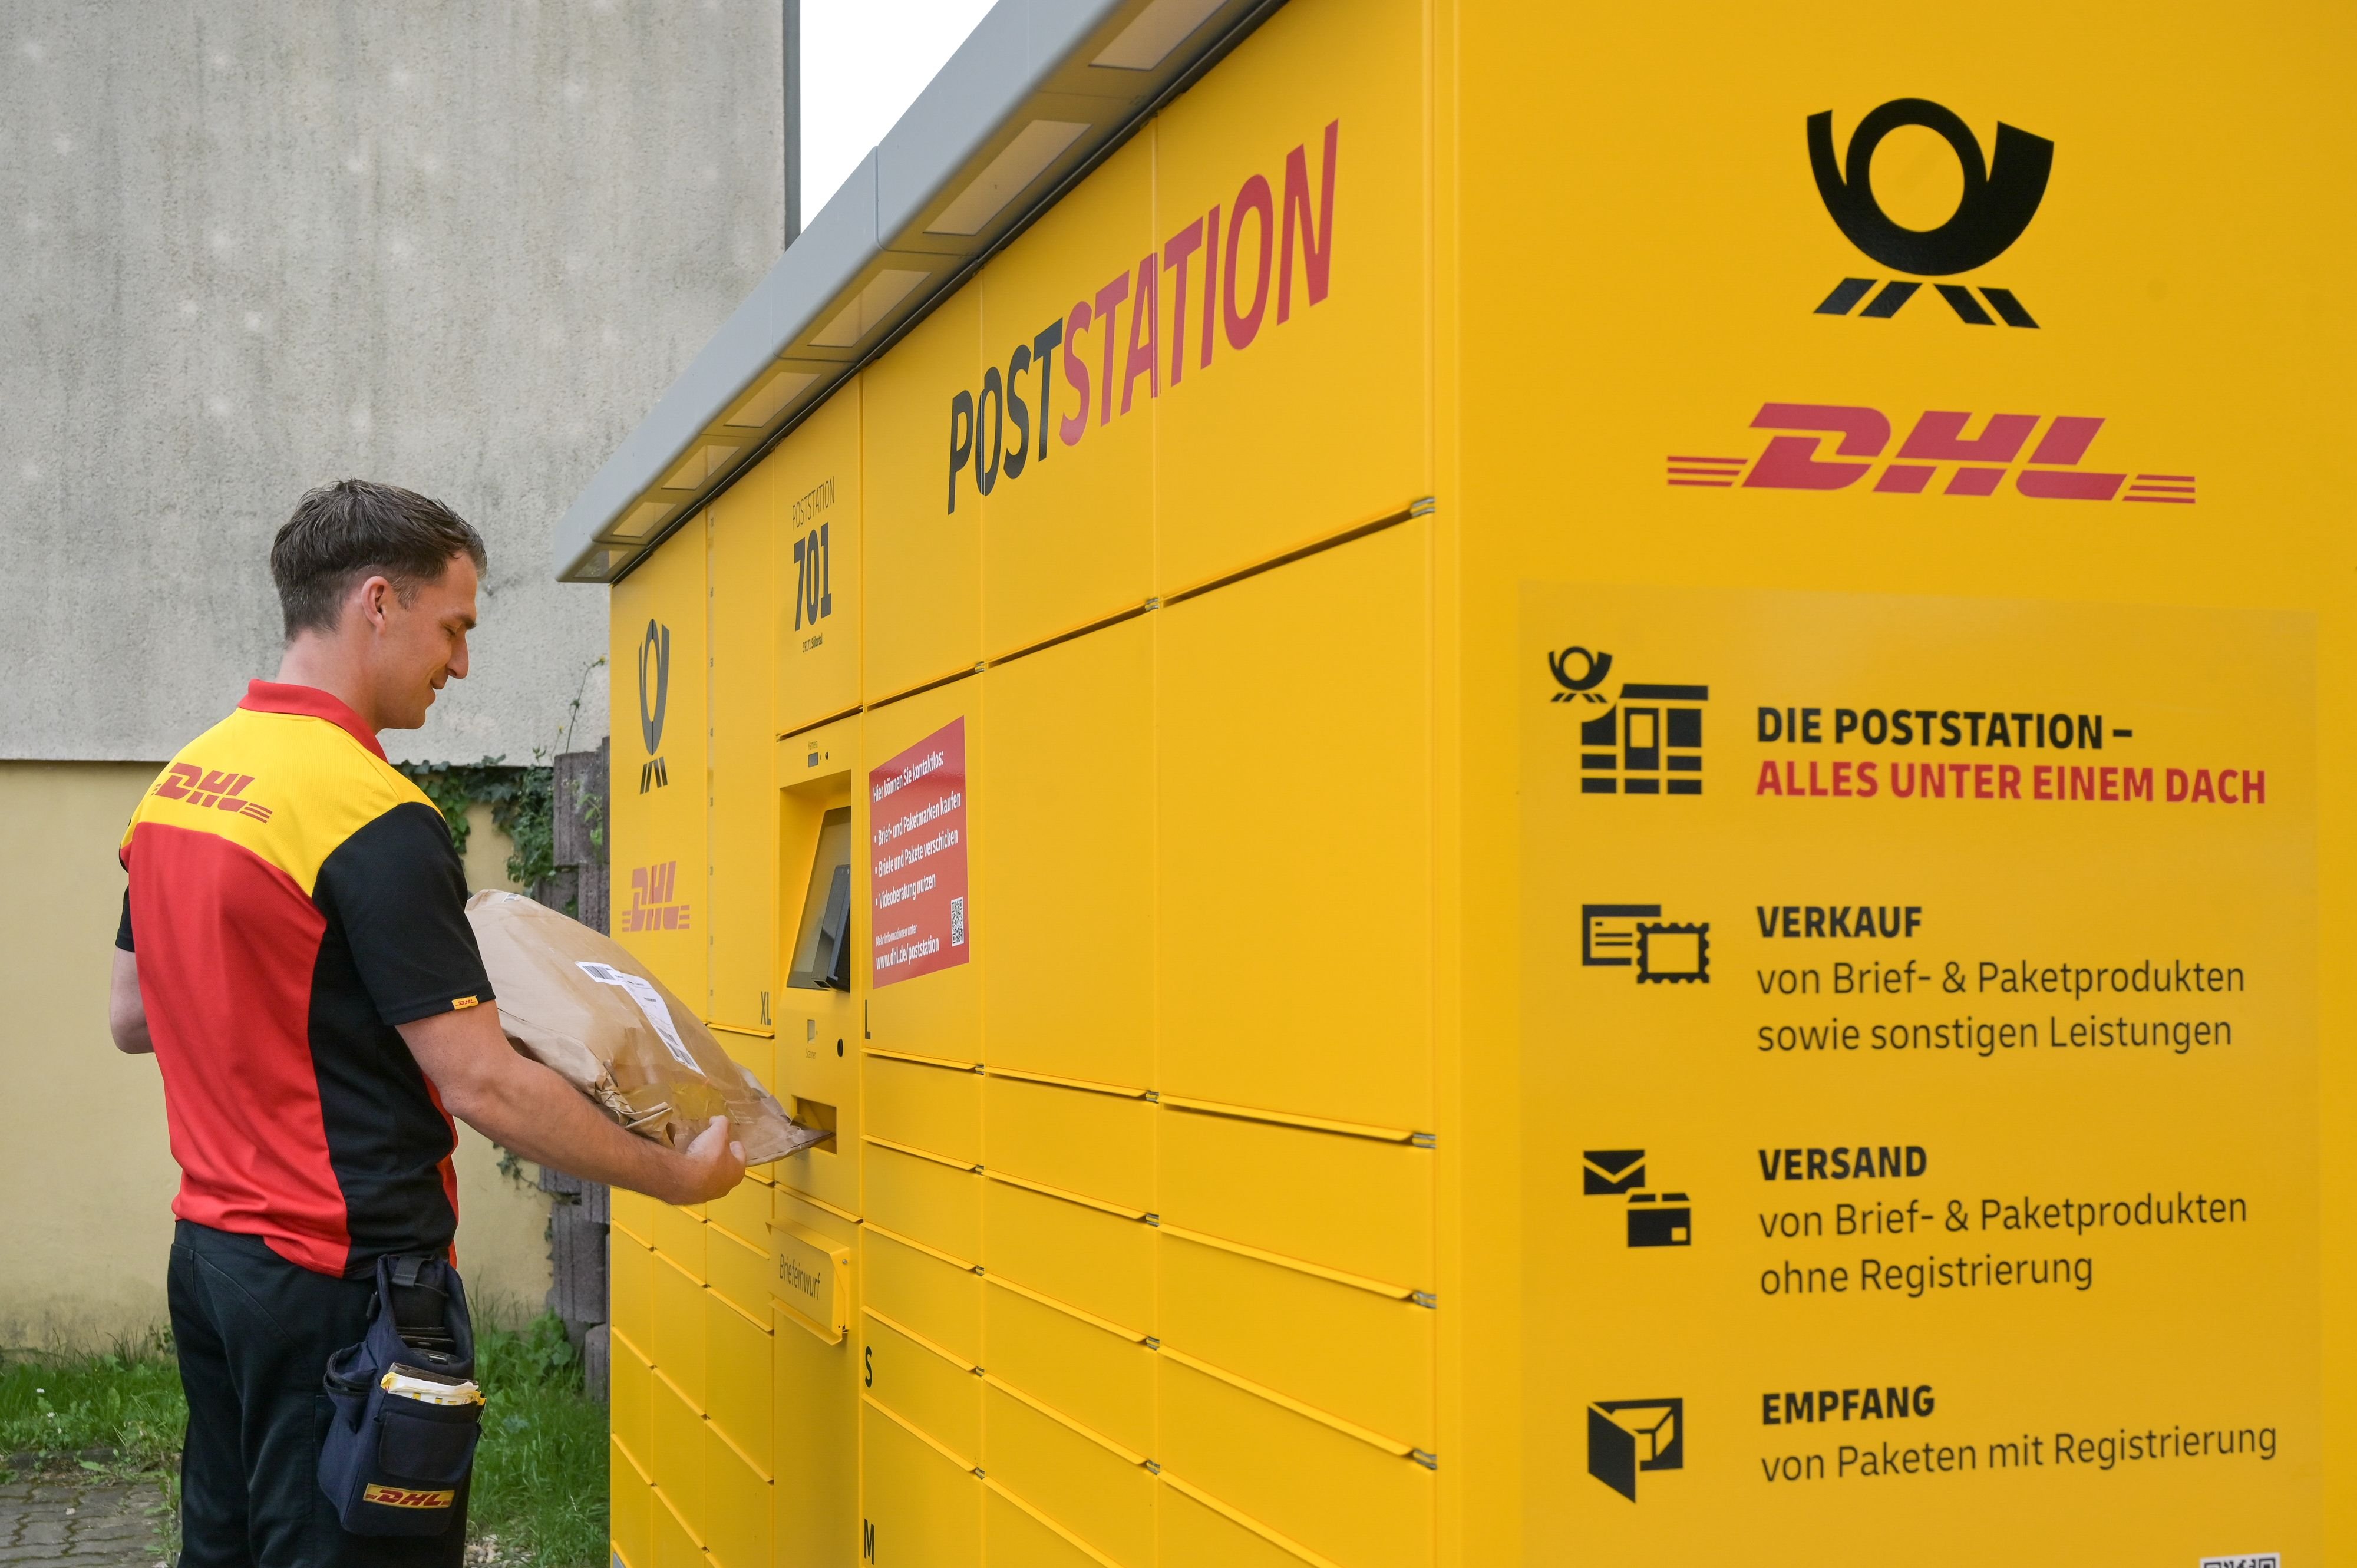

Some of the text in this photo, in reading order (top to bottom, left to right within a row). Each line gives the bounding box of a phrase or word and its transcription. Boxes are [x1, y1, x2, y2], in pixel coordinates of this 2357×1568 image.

[948, 118, 1339, 516] POSTSTATION
[1741, 403, 2128, 501] DHL
[792, 476, 834, 531] POSTSTATION
[794, 522, 831, 632] 701
[1758, 707, 1823, 744] DIE
[1835, 708, 2103, 750] POSTSTATION
[155, 762, 255, 812] DHL
[873, 751, 944, 803] Hier können Sie kontaktlos:
[1757, 761, 2266, 804] ALLES UNTER EINEM DACH
[878, 790, 961, 846] Brief- und Paketmarken kaufen
[879, 828, 958, 877] Briefe und Pakete verschicken
[630, 860, 679, 932] DHL
[879, 873, 936, 909] Videoberatung nutzen
[876, 924, 917, 947] Mehr Informationen unter
[1757, 906, 1922, 939] VERKAUF
[876, 935, 939, 970] www.dhl.de/poststation
[1757, 960, 2244, 1001] von Brief- & Paketprodukten
[761, 991, 771, 1026] XL
[864, 999, 871, 1039] L
[1758, 1015, 2231, 1058] sowie sonstigen Leistungen
[1758, 1146, 1927, 1181] VERSAND
[1760, 1192, 2246, 1238] von Brief- & Paketprodukten
[780, 1253, 821, 1300] Briefeinwurf
[1761, 1254, 2092, 1299] ohne Registrierung
[864, 1346, 872, 1388] S
[1763, 1385, 1935, 1425] EMPFANG
[1762, 1426, 2276, 1482] von Paketen mit Registrierung
[377, 1489, 441, 1506] DHL
[864, 1518, 874, 1566] M
